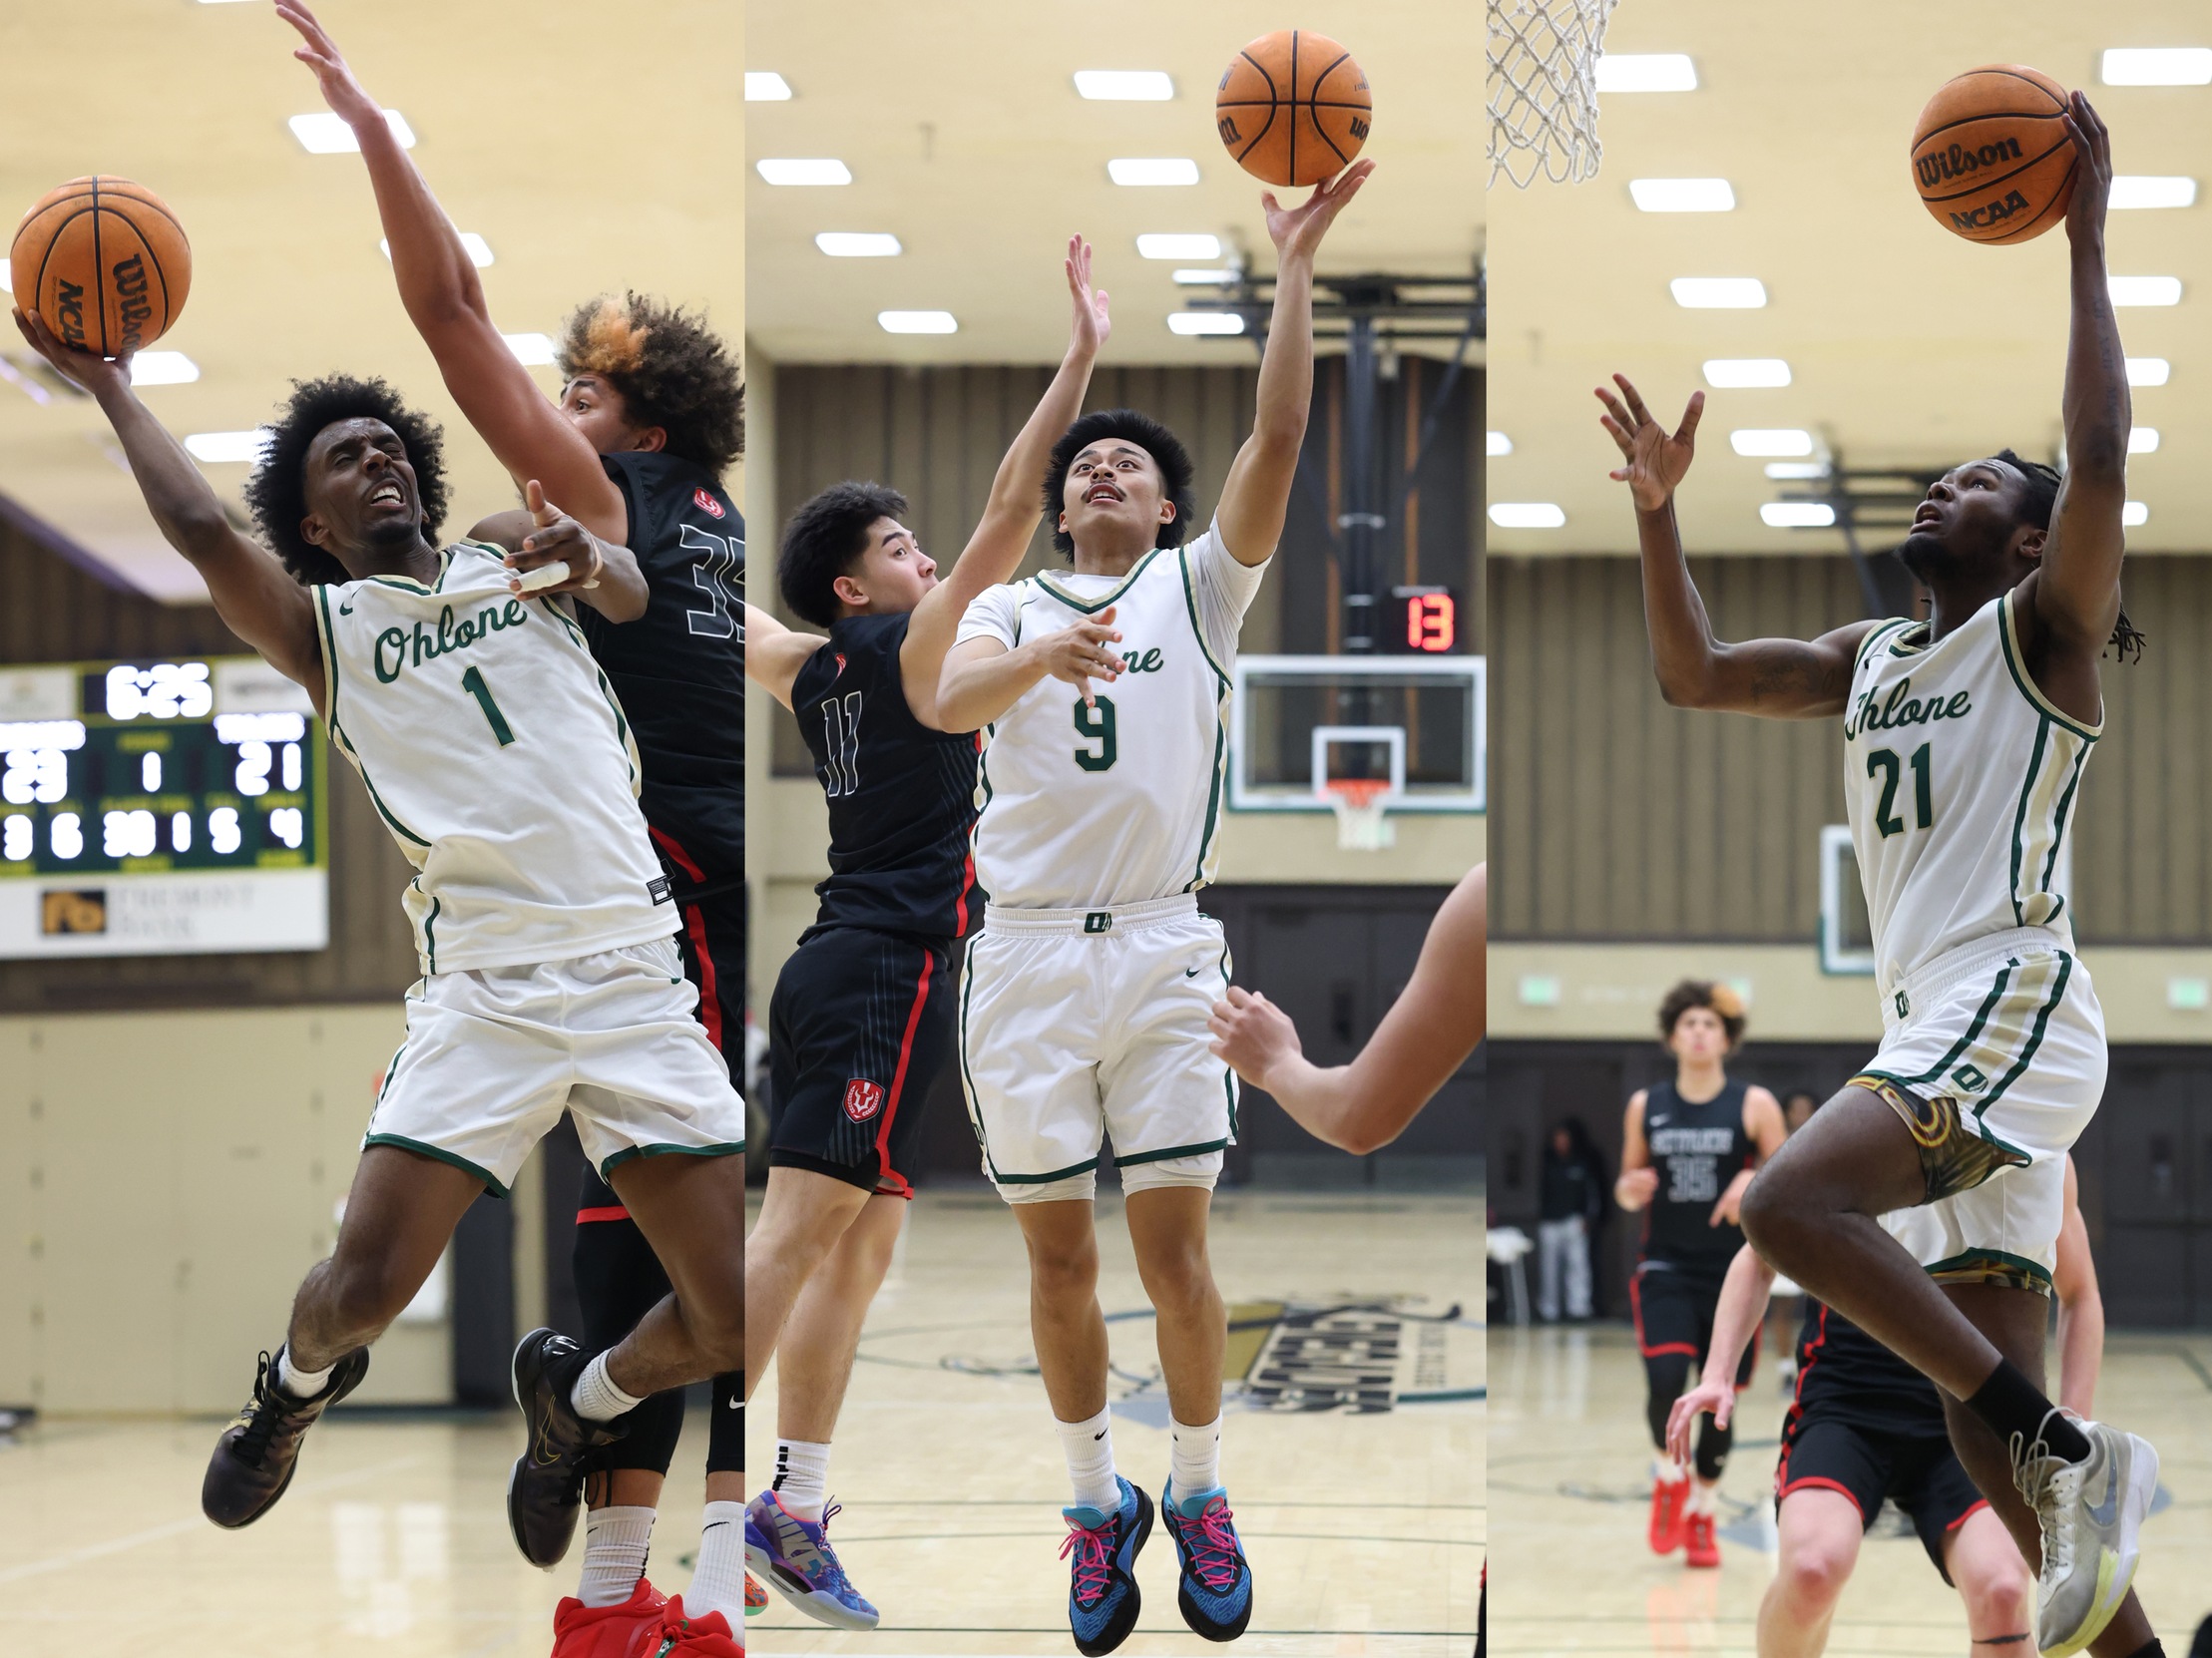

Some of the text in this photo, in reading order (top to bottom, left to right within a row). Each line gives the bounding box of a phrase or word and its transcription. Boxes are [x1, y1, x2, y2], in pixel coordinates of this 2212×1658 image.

[1916, 137, 2023, 189] Wilson
[1949, 189, 2030, 229] NCAA
[374, 599, 528, 684] Ohlone
[1408, 594, 1454, 651] 13
[106, 662, 213, 720] 6:25
[461, 664, 517, 748] 1
[821, 690, 863, 798] 11
[1072, 692, 1119, 774] 9
[142, 751, 162, 792] 1
[235, 740, 302, 796] 21
[1866, 740, 1934, 841] 21
